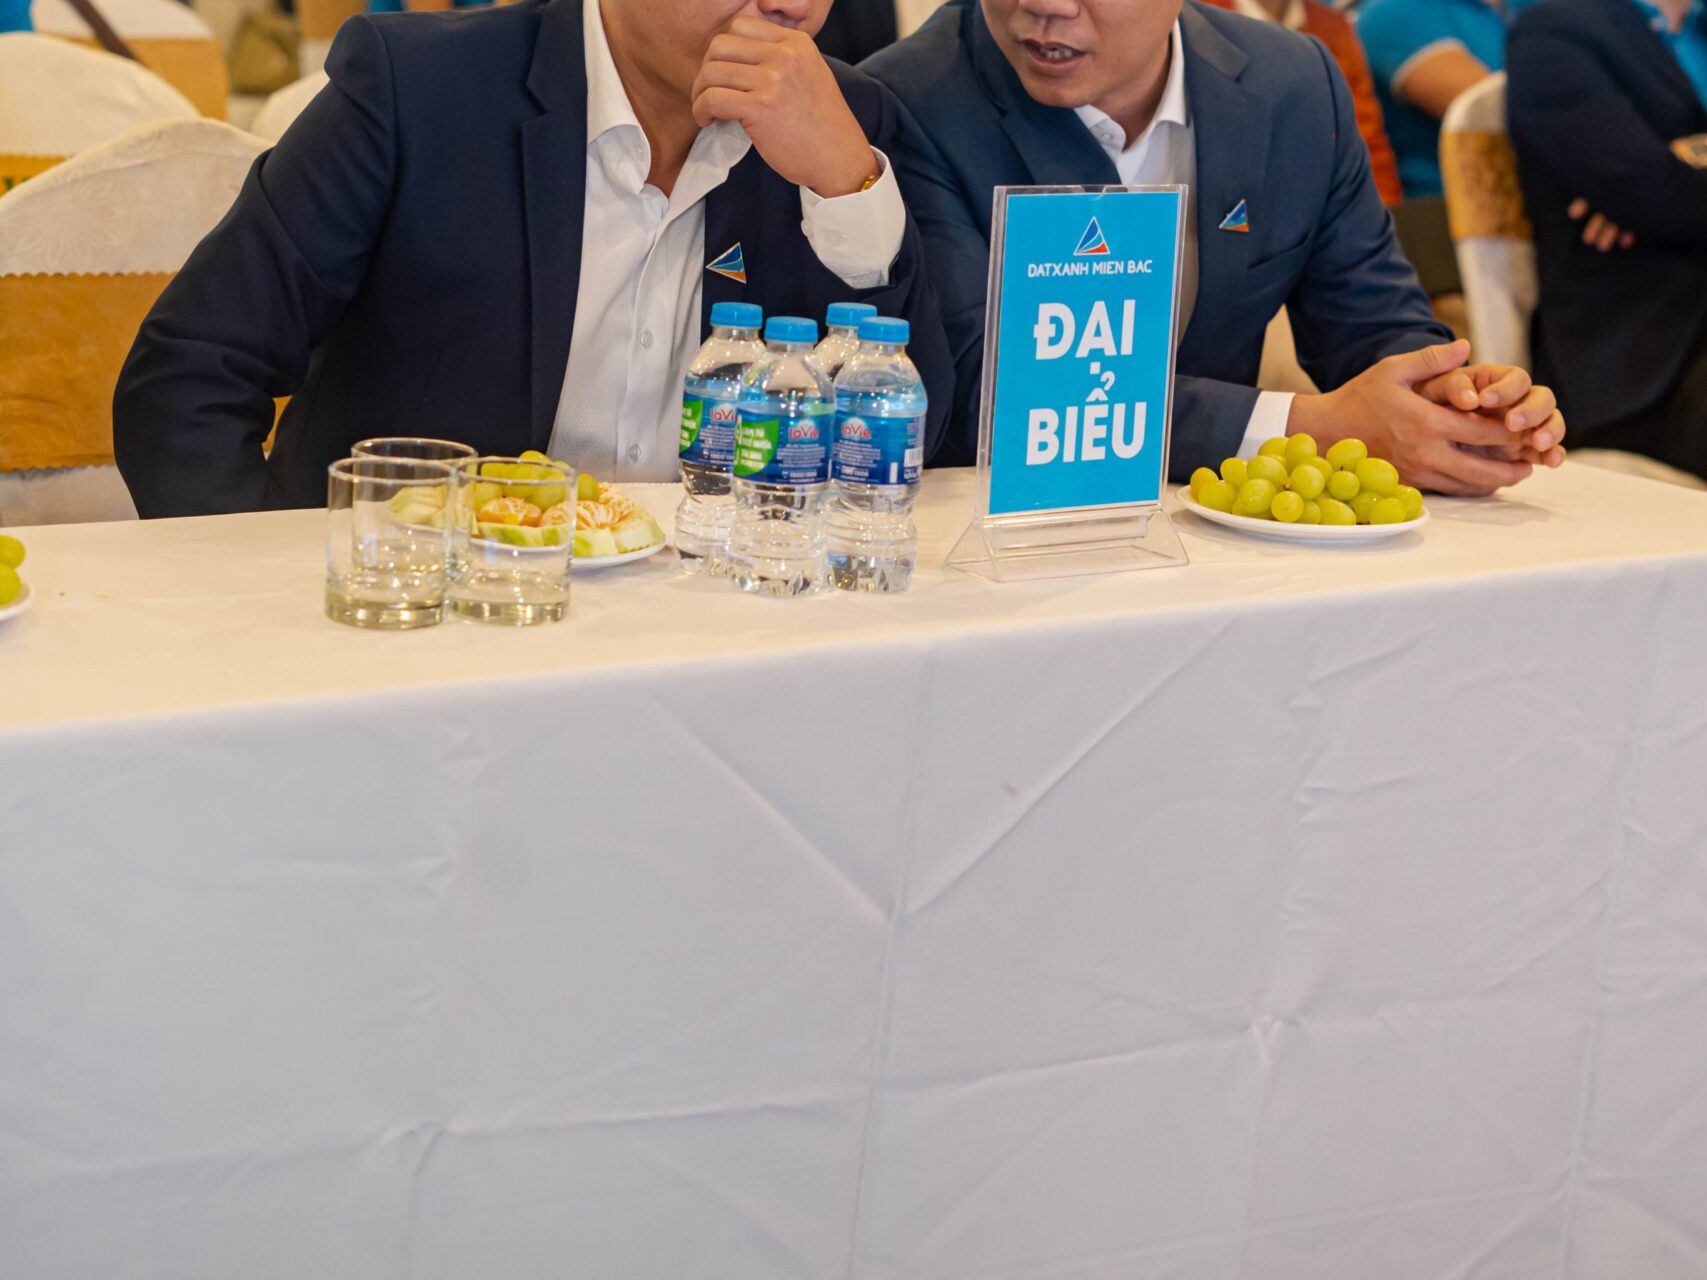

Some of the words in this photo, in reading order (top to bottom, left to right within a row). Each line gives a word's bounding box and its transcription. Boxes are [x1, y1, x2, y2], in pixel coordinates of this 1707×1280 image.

[1027, 262, 1090, 278] DATXANH
[1092, 260, 1125, 275] MIEN
[1126, 259, 1153, 274] BAC
[1033, 298, 1136, 375] ĐẠI
[1025, 370, 1147, 466] BIỂU
